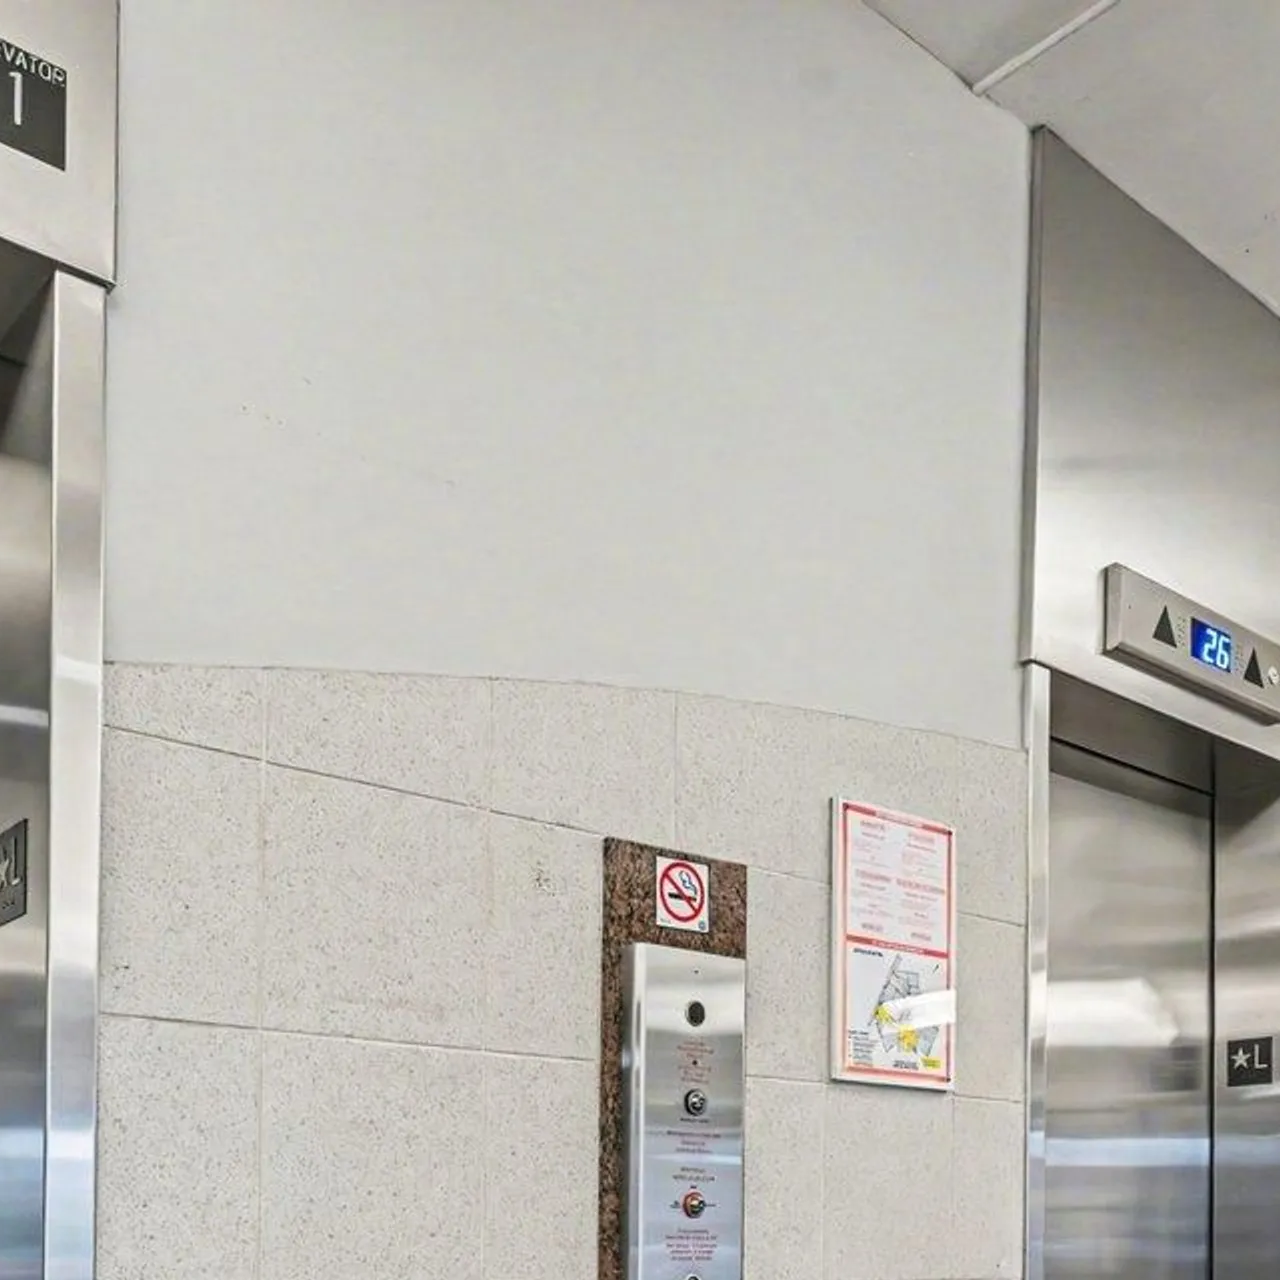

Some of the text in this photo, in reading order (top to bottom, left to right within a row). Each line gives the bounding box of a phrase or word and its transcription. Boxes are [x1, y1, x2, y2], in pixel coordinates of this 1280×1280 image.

[8, 71, 23, 126] 1
[1202, 628, 1230, 670] 26
[1254, 1044, 1268, 1069] L
